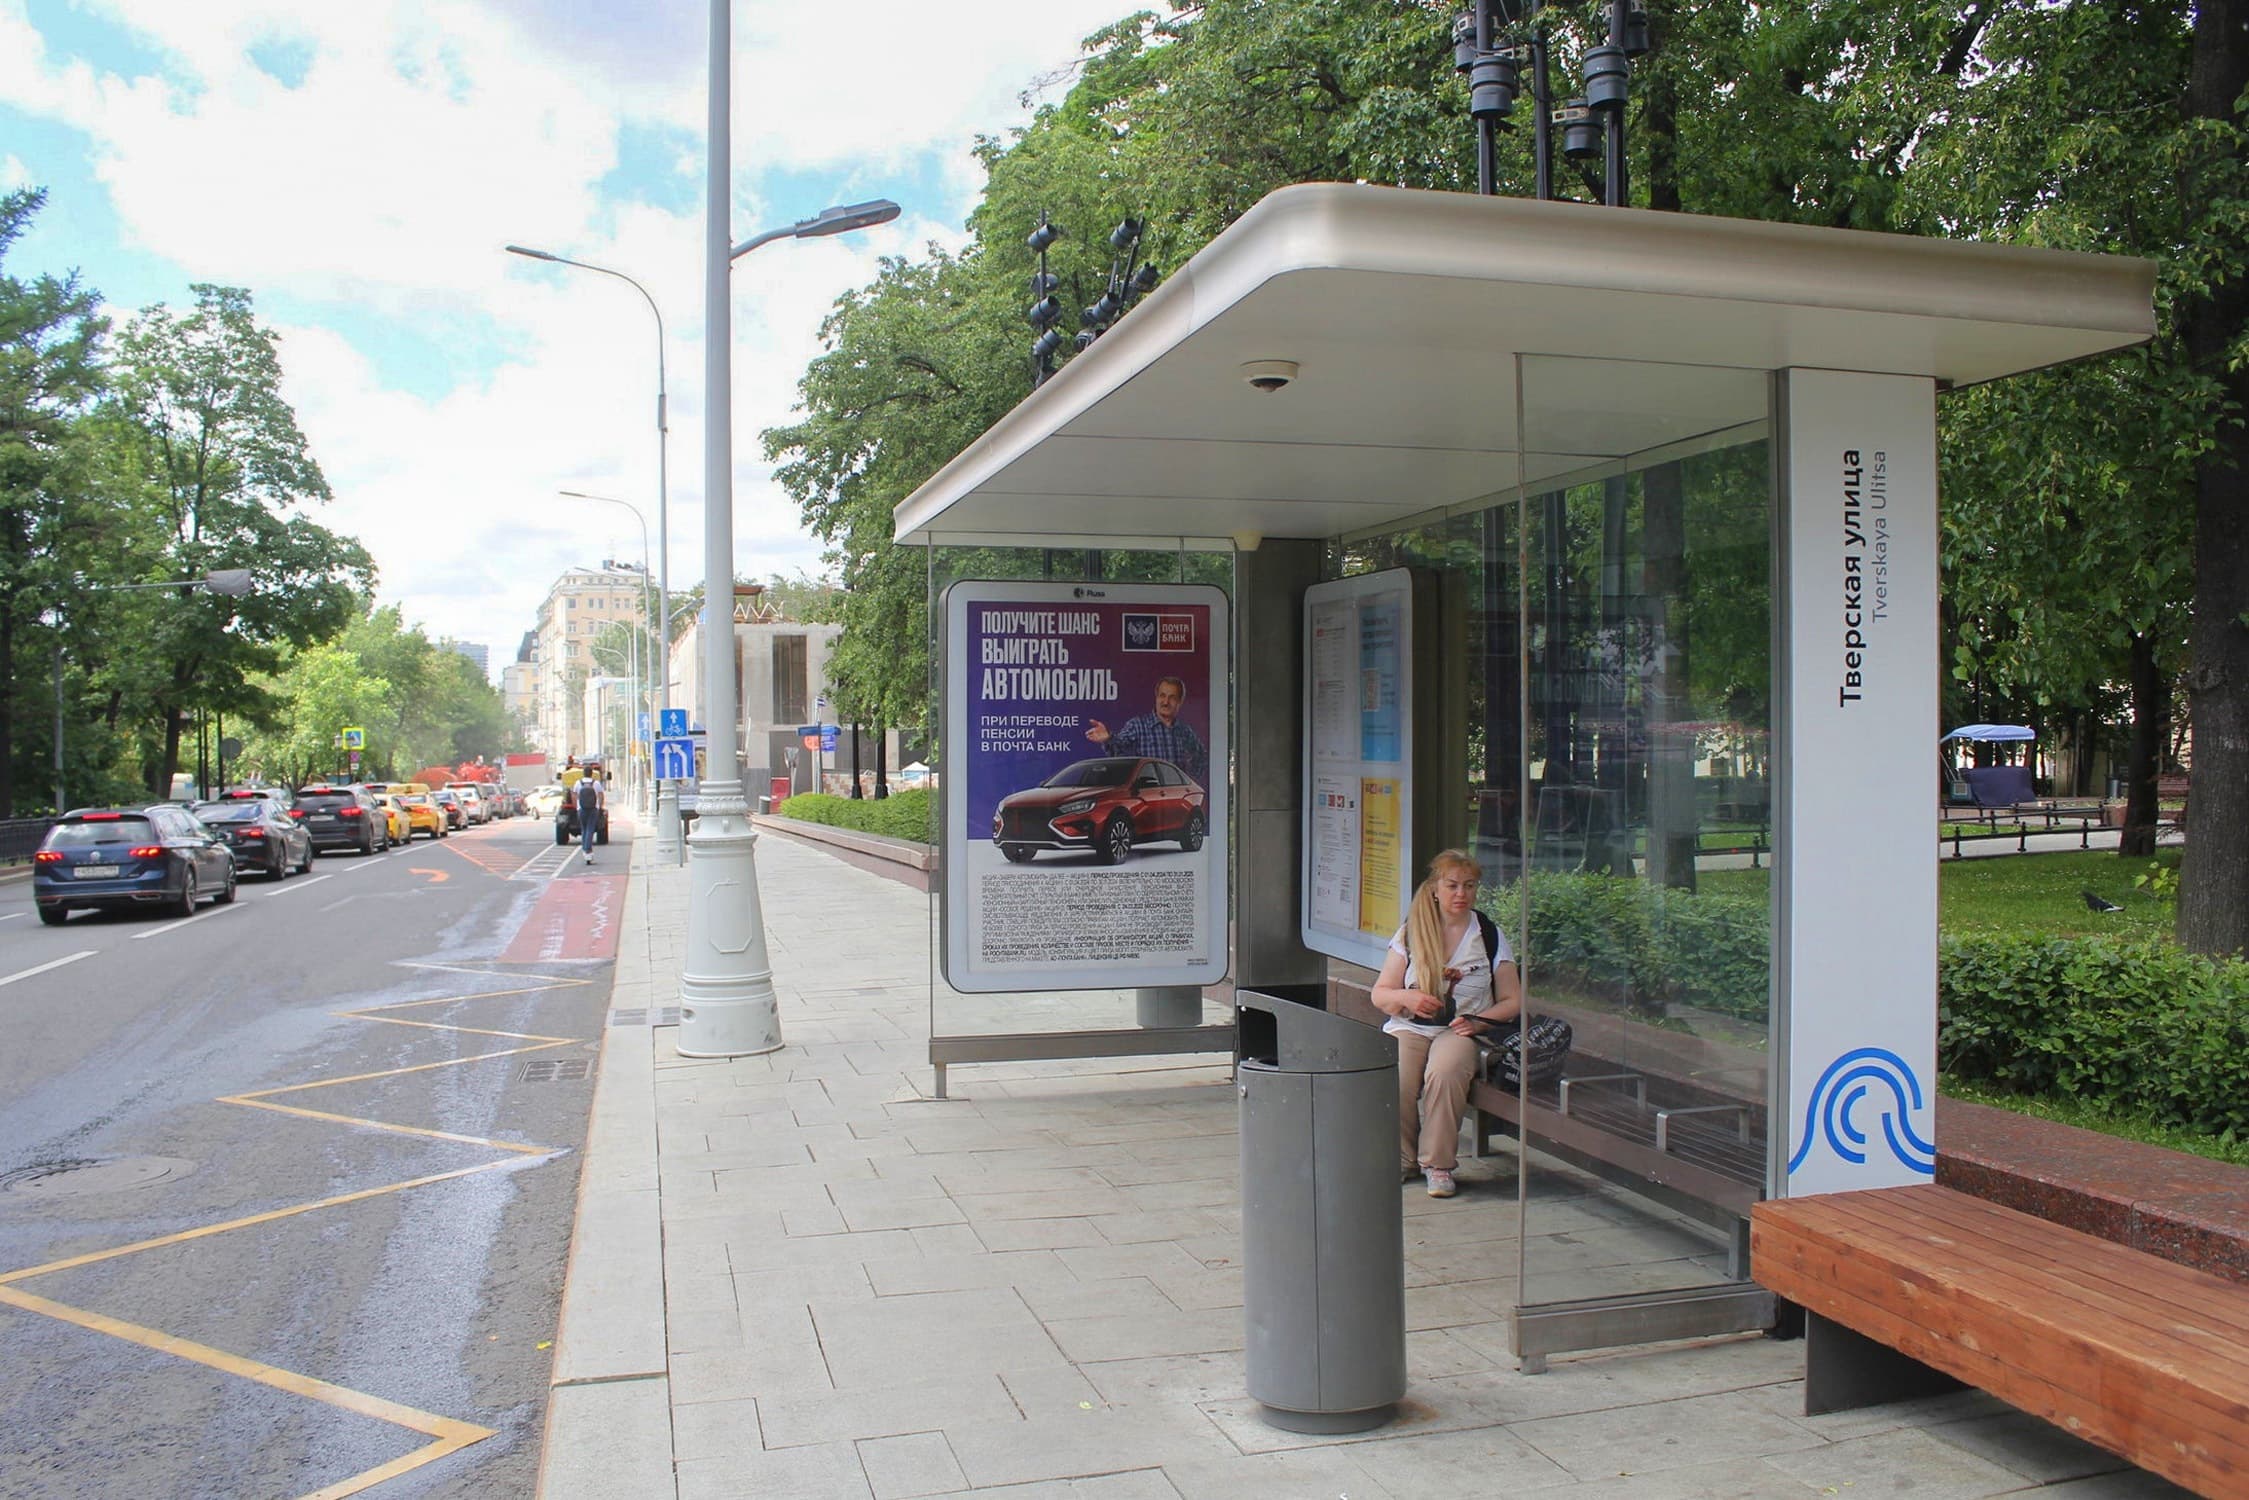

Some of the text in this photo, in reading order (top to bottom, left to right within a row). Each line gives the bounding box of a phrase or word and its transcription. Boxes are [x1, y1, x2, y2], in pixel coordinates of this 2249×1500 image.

[1871, 451, 1890, 623] Tverskaya Ulitsa
[1840, 449, 1866, 708] Тверская улица
[981, 611, 1101, 636] ПОЛУЧИТЕ ШАНС
[1162, 623, 1190, 633] ПОЧТА
[1162, 633, 1187, 643] БАНК
[981, 638, 1069, 665] ВЫИГРАТЬ
[981, 668, 1119, 701] АВТОМОБИЛЬ
[981, 715, 1079, 727] ПРИ ПЕРЕВОДЕ
[981, 728, 1035, 739] ПЕНСИИ
[981, 741, 1072, 752] В ПОЧТА БАНК
